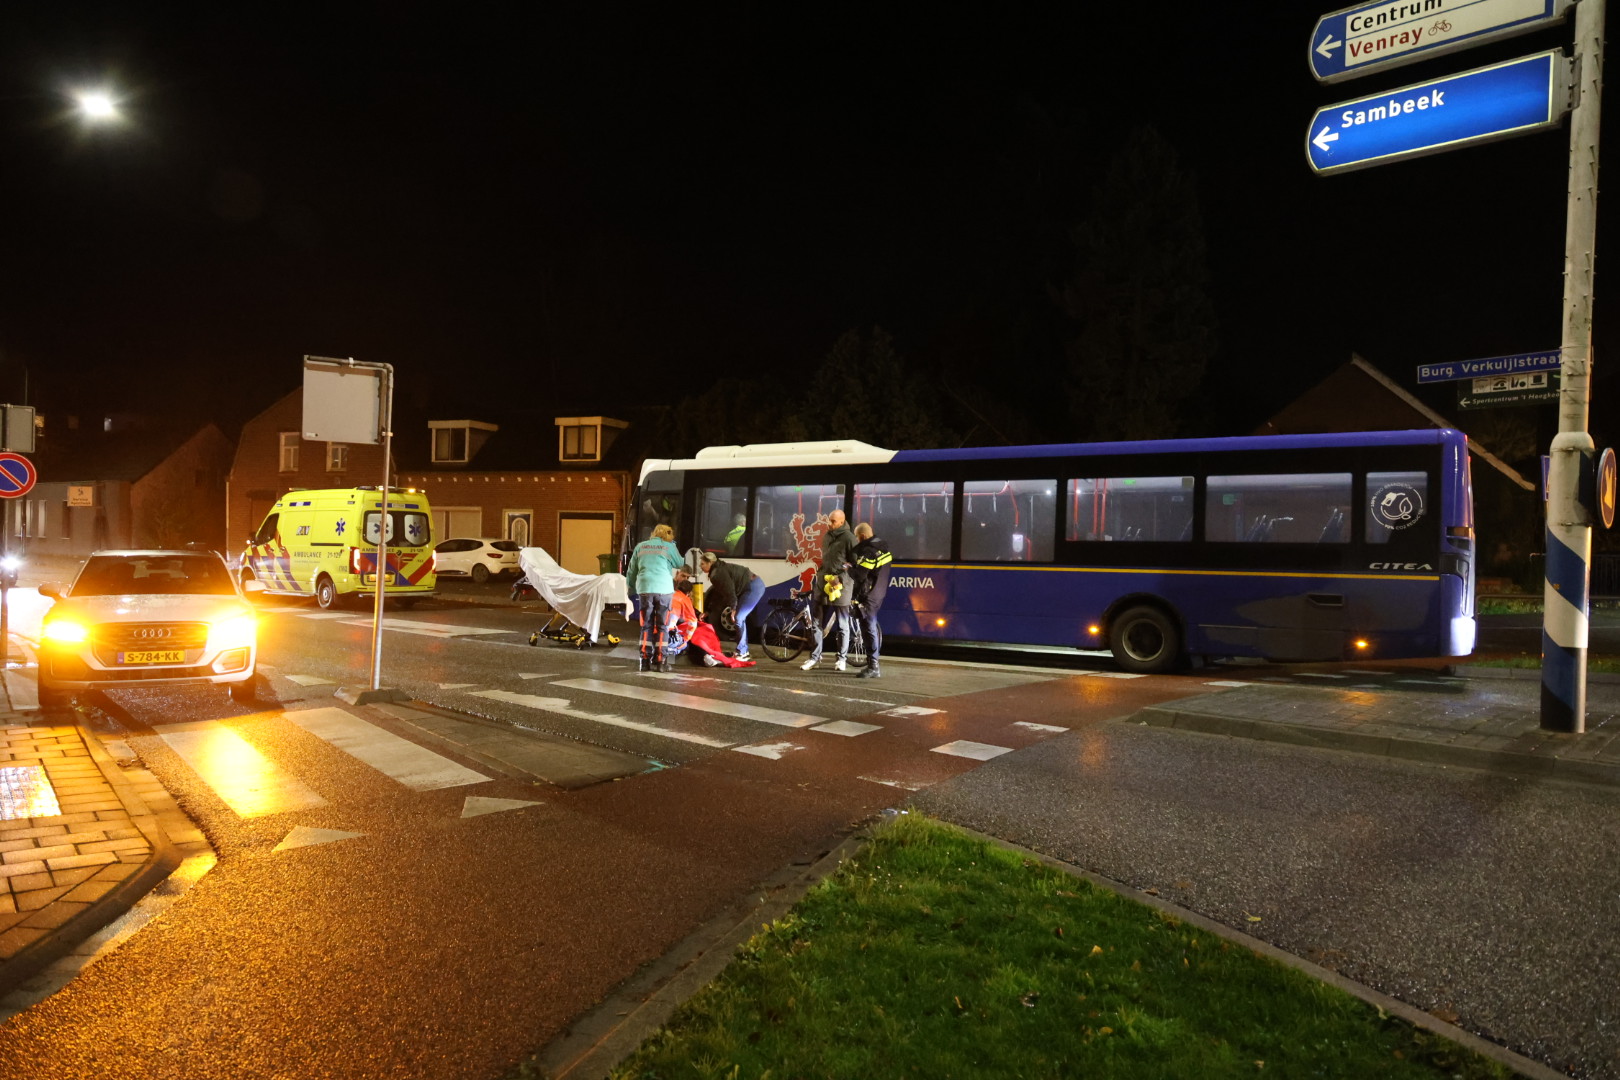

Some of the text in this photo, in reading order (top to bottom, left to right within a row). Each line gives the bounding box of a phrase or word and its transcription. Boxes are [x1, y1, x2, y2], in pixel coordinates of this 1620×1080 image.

[1350, 0, 1442, 32] Centrum
[1349, 27, 1423, 57] Venray
[1341, 89, 1445, 128] Sambeek
[1421, 366, 1455, 378] Burg.
[1369, 562, 1433, 570] CITEA
[889, 576, 934, 589] ARRIVA
[127, 651, 180, 662] S-784-KK
